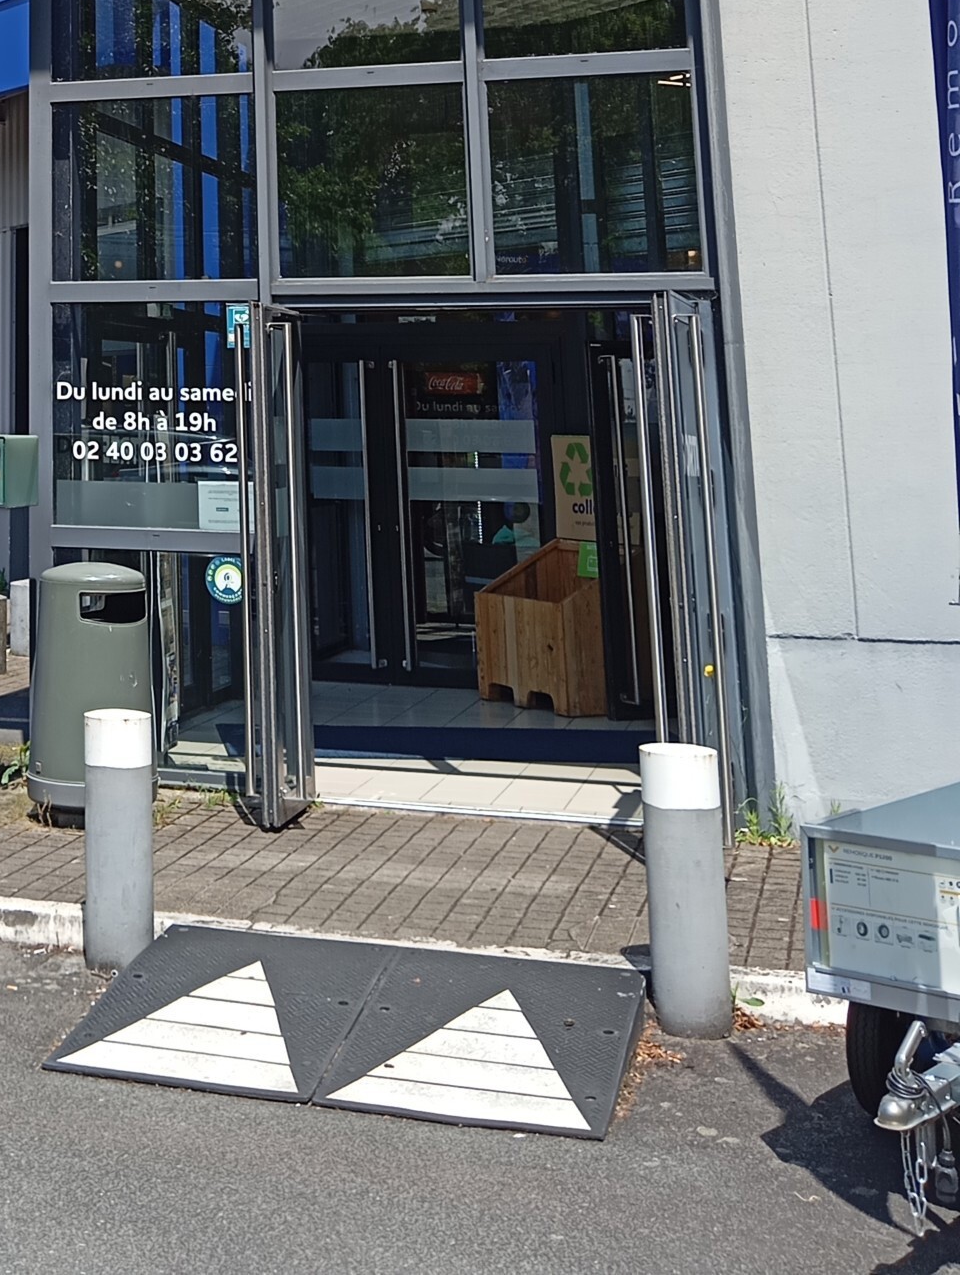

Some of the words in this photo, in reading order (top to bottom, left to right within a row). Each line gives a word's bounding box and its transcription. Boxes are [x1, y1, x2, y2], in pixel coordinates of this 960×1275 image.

[56, 381, 86, 401] Du
[92, 381, 143, 401] lundi
[148, 387, 173, 401] au
[92, 411, 117, 431] de
[123, 411, 150, 431] 8h
[156, 409, 168, 431] à
[175, 412, 217, 432] 19h
[72, 440, 100, 460] 02
[105, 441, 134, 461] 40
[140, 442, 167, 462] 03
[174, 442, 202, 462] 03
[209, 443, 238, 463] 62
[572, 498, 595, 515] coll
